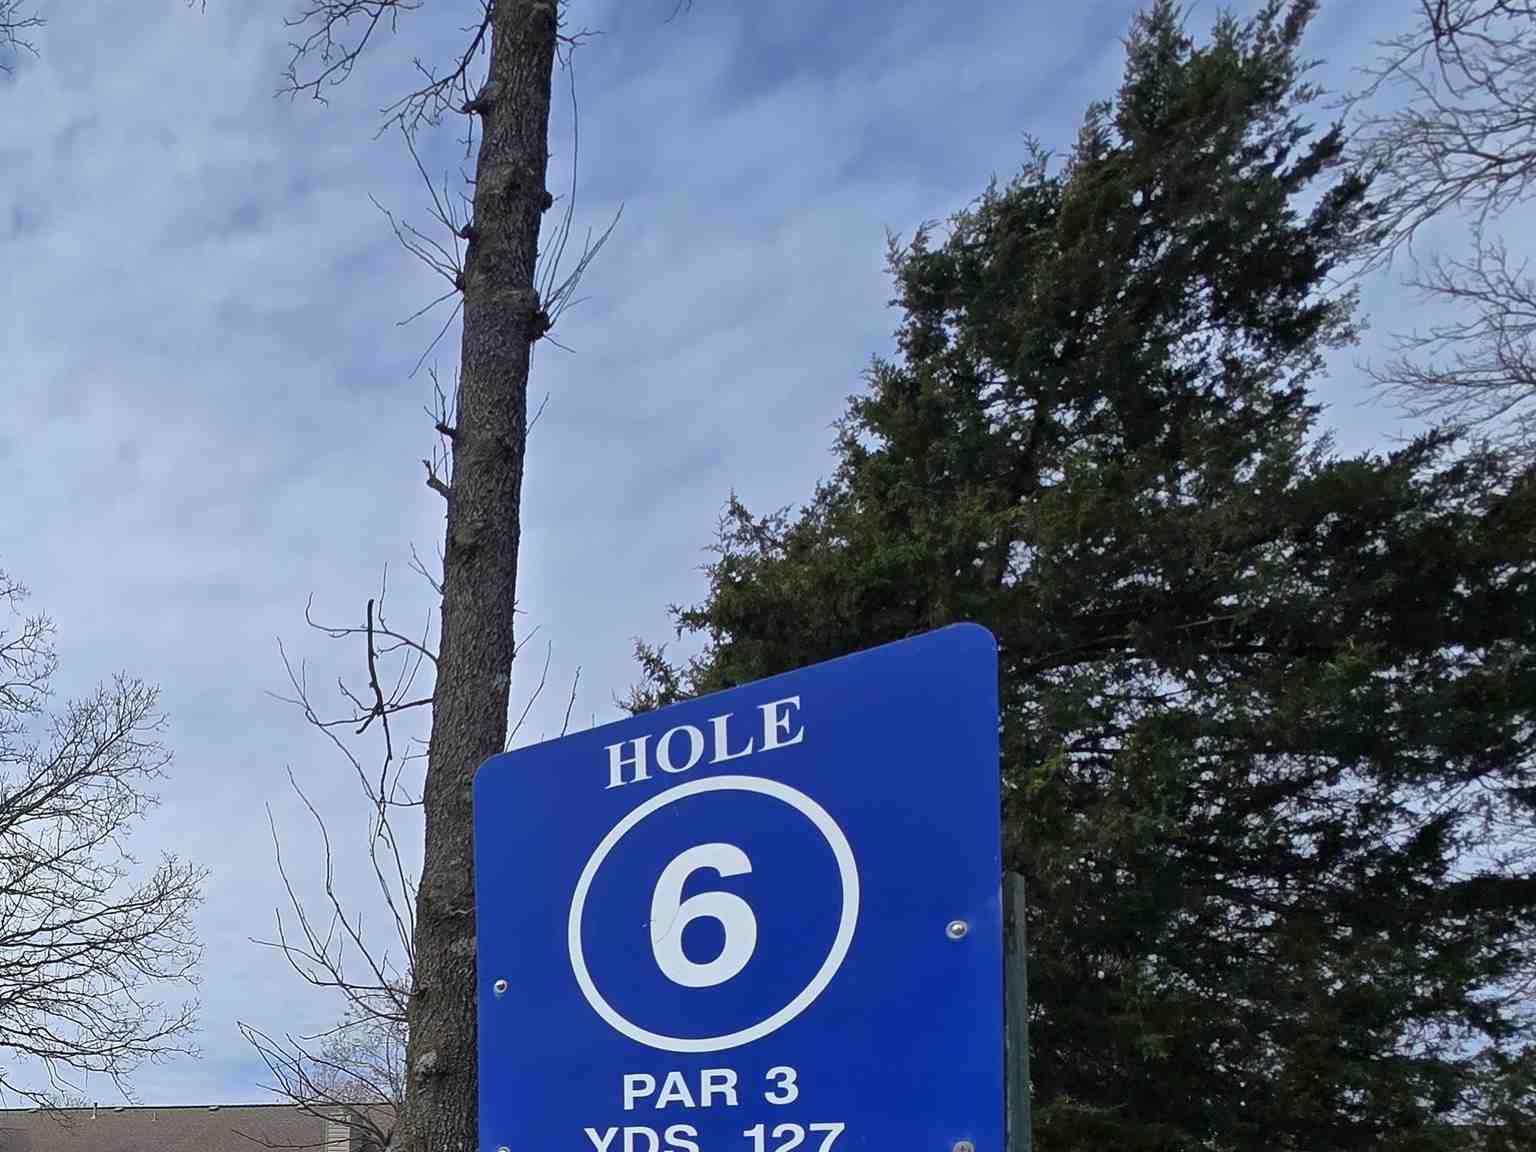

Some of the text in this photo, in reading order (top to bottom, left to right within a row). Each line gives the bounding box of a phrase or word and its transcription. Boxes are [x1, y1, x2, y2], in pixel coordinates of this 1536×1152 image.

[605, 695, 805, 790] HOLE
[650, 842, 758, 988] 6
[623, 1066, 800, 1110] PAR 3
